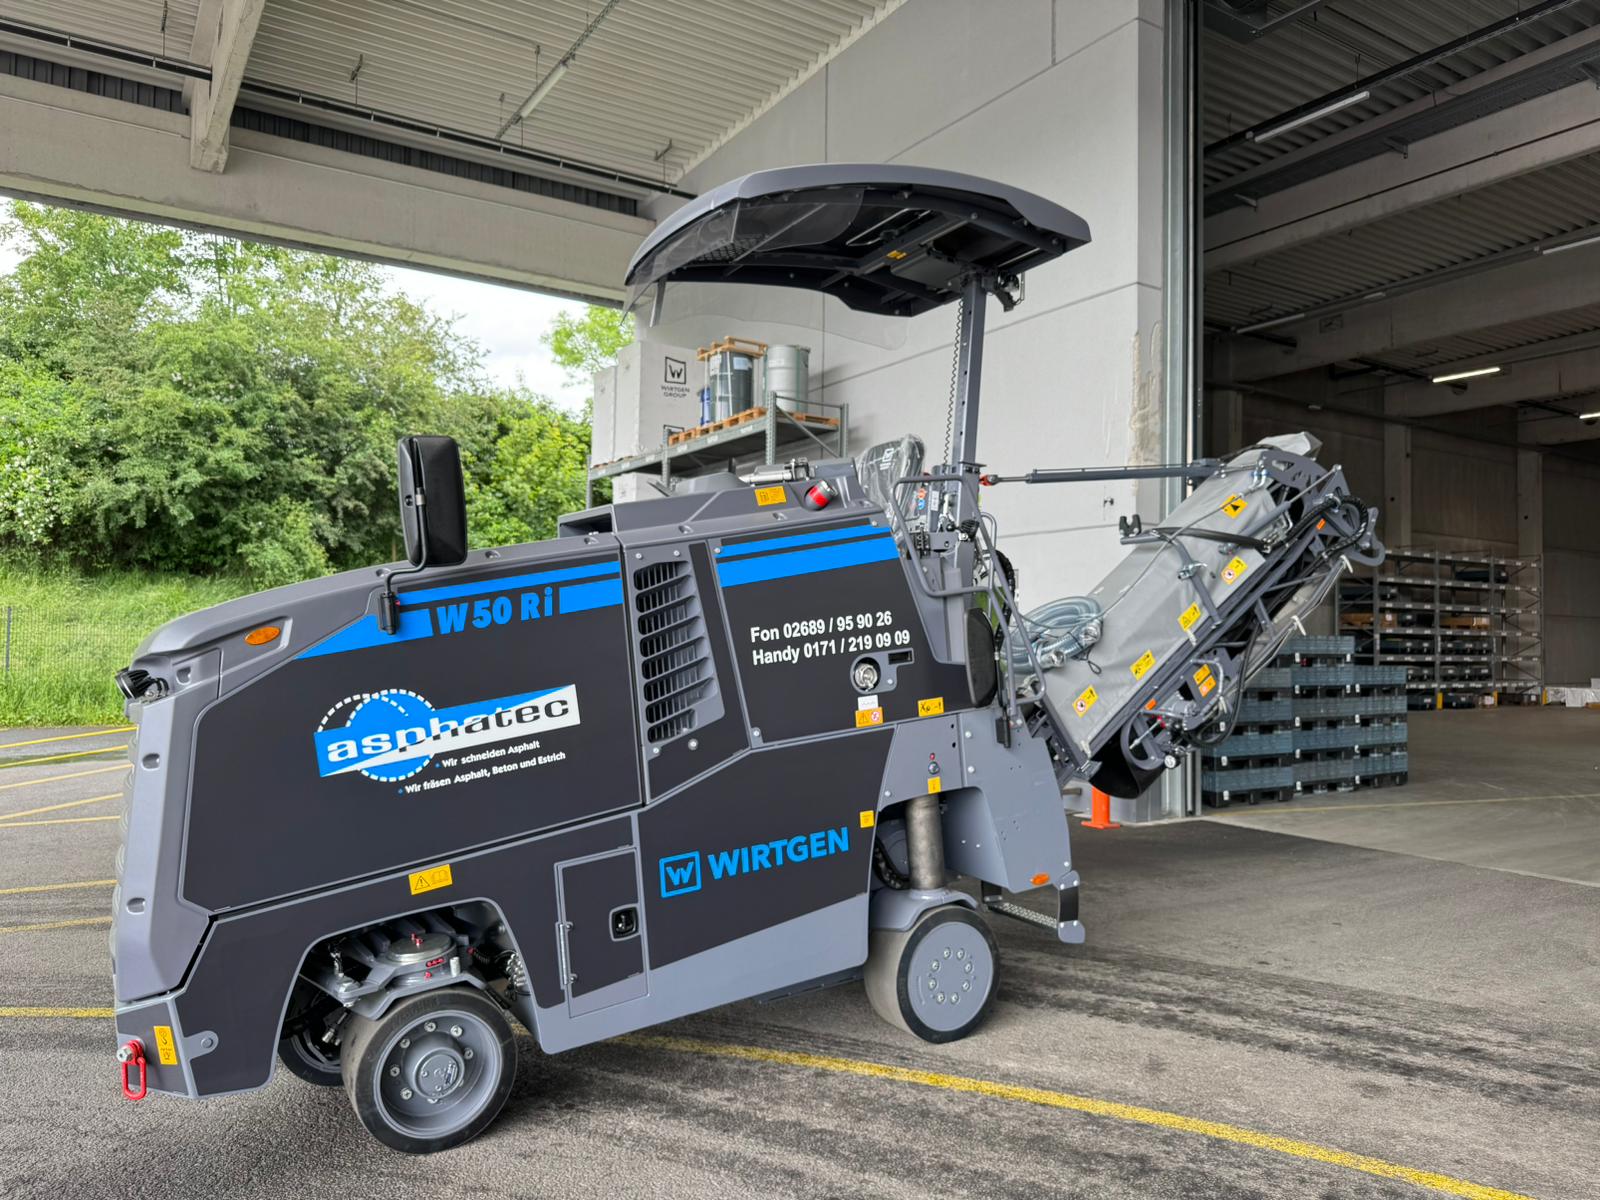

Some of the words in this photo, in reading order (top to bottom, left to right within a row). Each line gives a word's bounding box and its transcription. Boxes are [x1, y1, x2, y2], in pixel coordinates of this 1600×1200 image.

[663, 391, 687, 399] GROUP
[521, 586, 553, 621] Ri
[750, 627, 780, 643] Fon
[783, 619, 825, 639] 02689
[836, 615, 854, 632] 95
[856, 613, 873, 629] 90
[876, 610, 892, 627] 26
[752, 645, 800, 665] Handy
[803, 639, 836, 658] 0171
[848, 635, 873, 652] 219
[875, 632, 892, 648] 09
[894, 629, 911, 645] 09
[327, 699, 569, 763] asphatec
[442, 758, 458, 768] Wir
[461, 750, 506, 765] schneiden
[507, 740, 540, 755] Asphalt
[405, 783, 422, 794] Wir
[423, 778, 451, 790] fräsen
[454, 768, 491, 784] Asphalt,
[492, 762, 519, 775] Beton
[519, 757, 537, 769] und
[538, 751, 566, 764] Estrich
[707, 826, 850, 880] WIRTGEN
